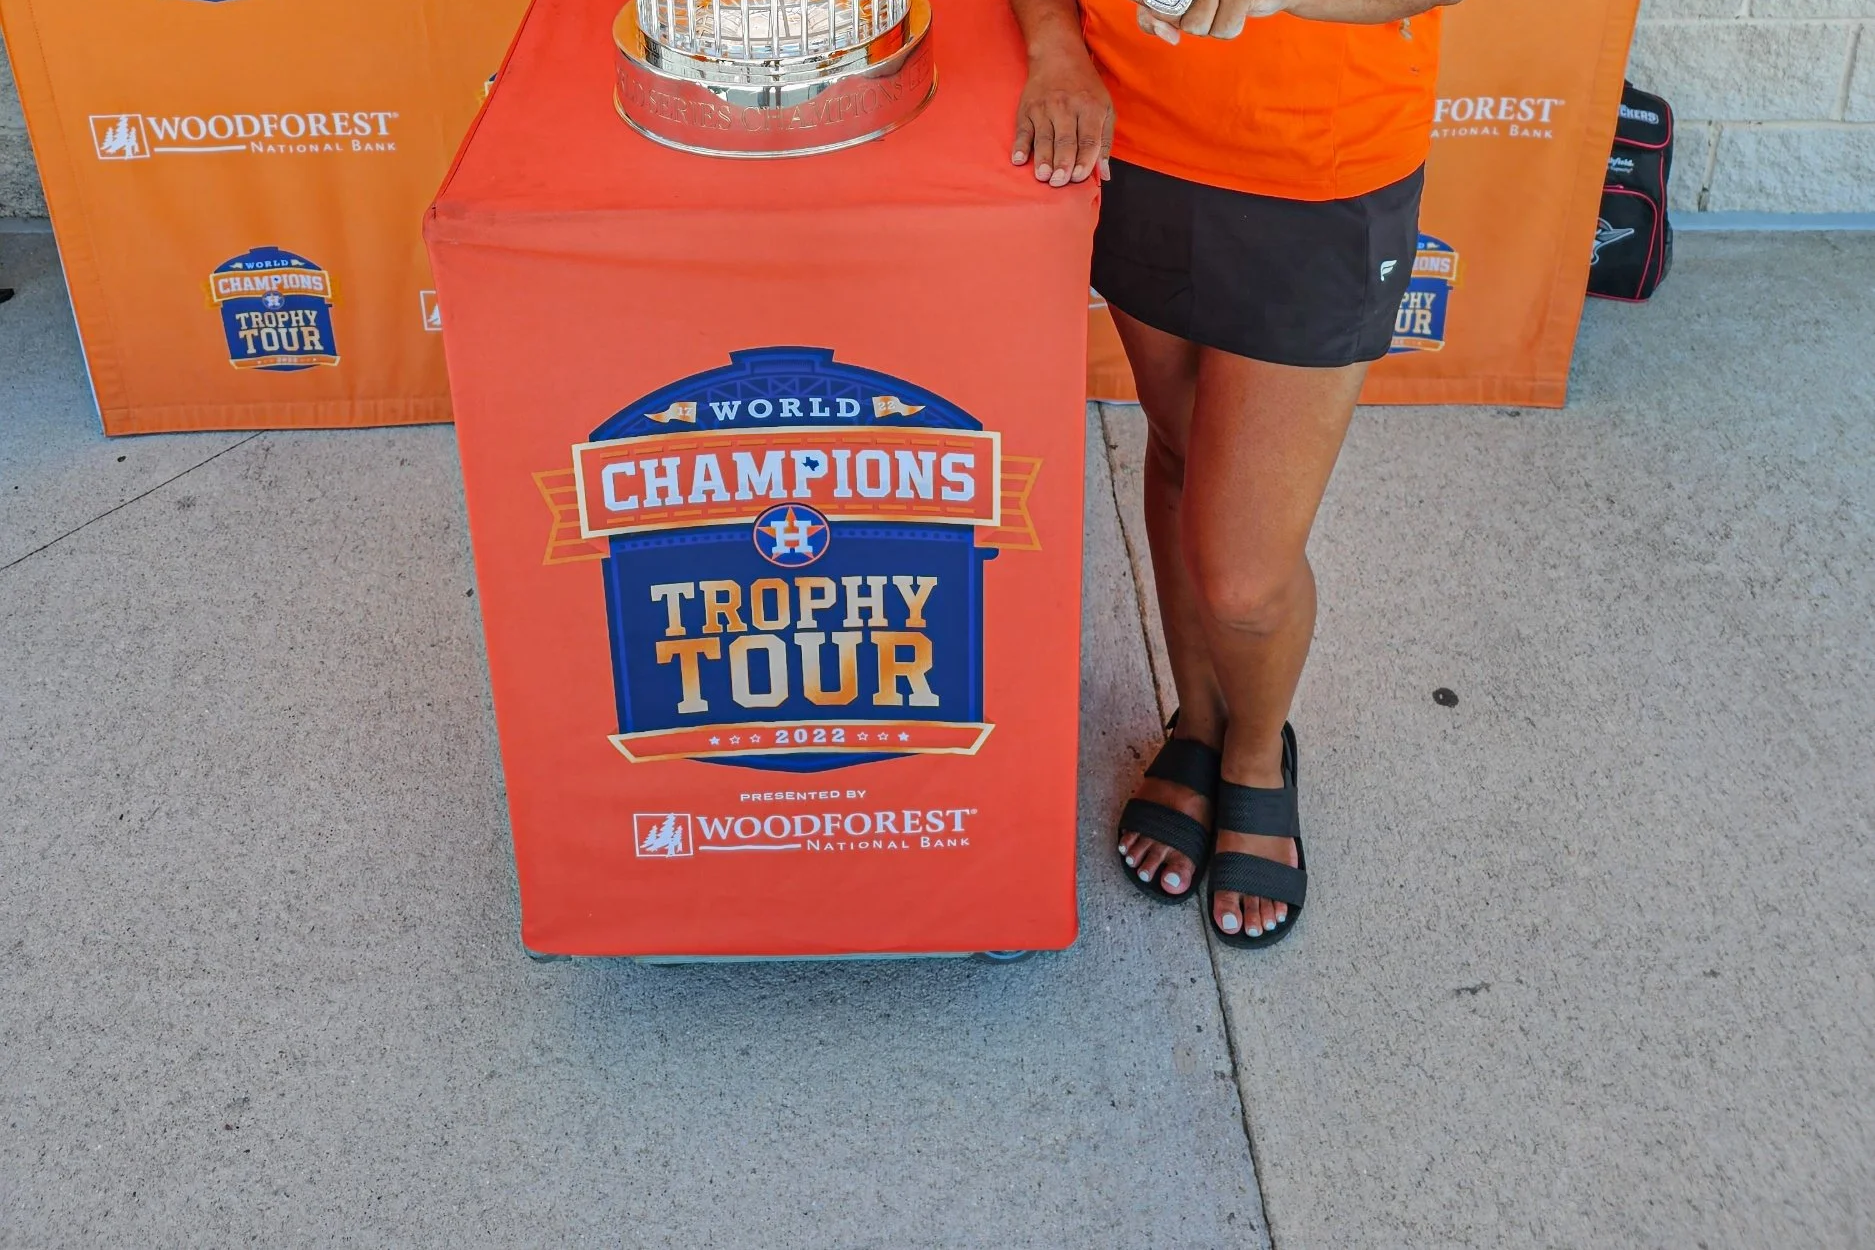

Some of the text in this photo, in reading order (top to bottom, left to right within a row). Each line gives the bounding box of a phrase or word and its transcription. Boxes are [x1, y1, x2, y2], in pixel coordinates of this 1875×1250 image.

[649, 89, 733, 131] SERIES
[741, 80, 903, 132] CHAMPIONS
[1430, 123, 1553, 139] ATIONAL BANK
[250, 139, 396, 154] NATIONAL BANK
[244, 259, 289, 269] WORLD
[218, 273, 324, 295] CHAMPIONS
[235, 309, 318, 330] TROPHY
[238, 326, 324, 355] TOUR
[677, 397, 897, 422] 17 WORLD 22
[601, 450, 975, 514] CHAMPIONS
[650, 575, 938, 636] TROPHY
[655, 631, 940, 715] TOUR
[775, 728, 845, 745] 2022
[740, 789, 867, 802] PRESENTED BY
[807, 836, 971, 852] NATIONAL BANK
